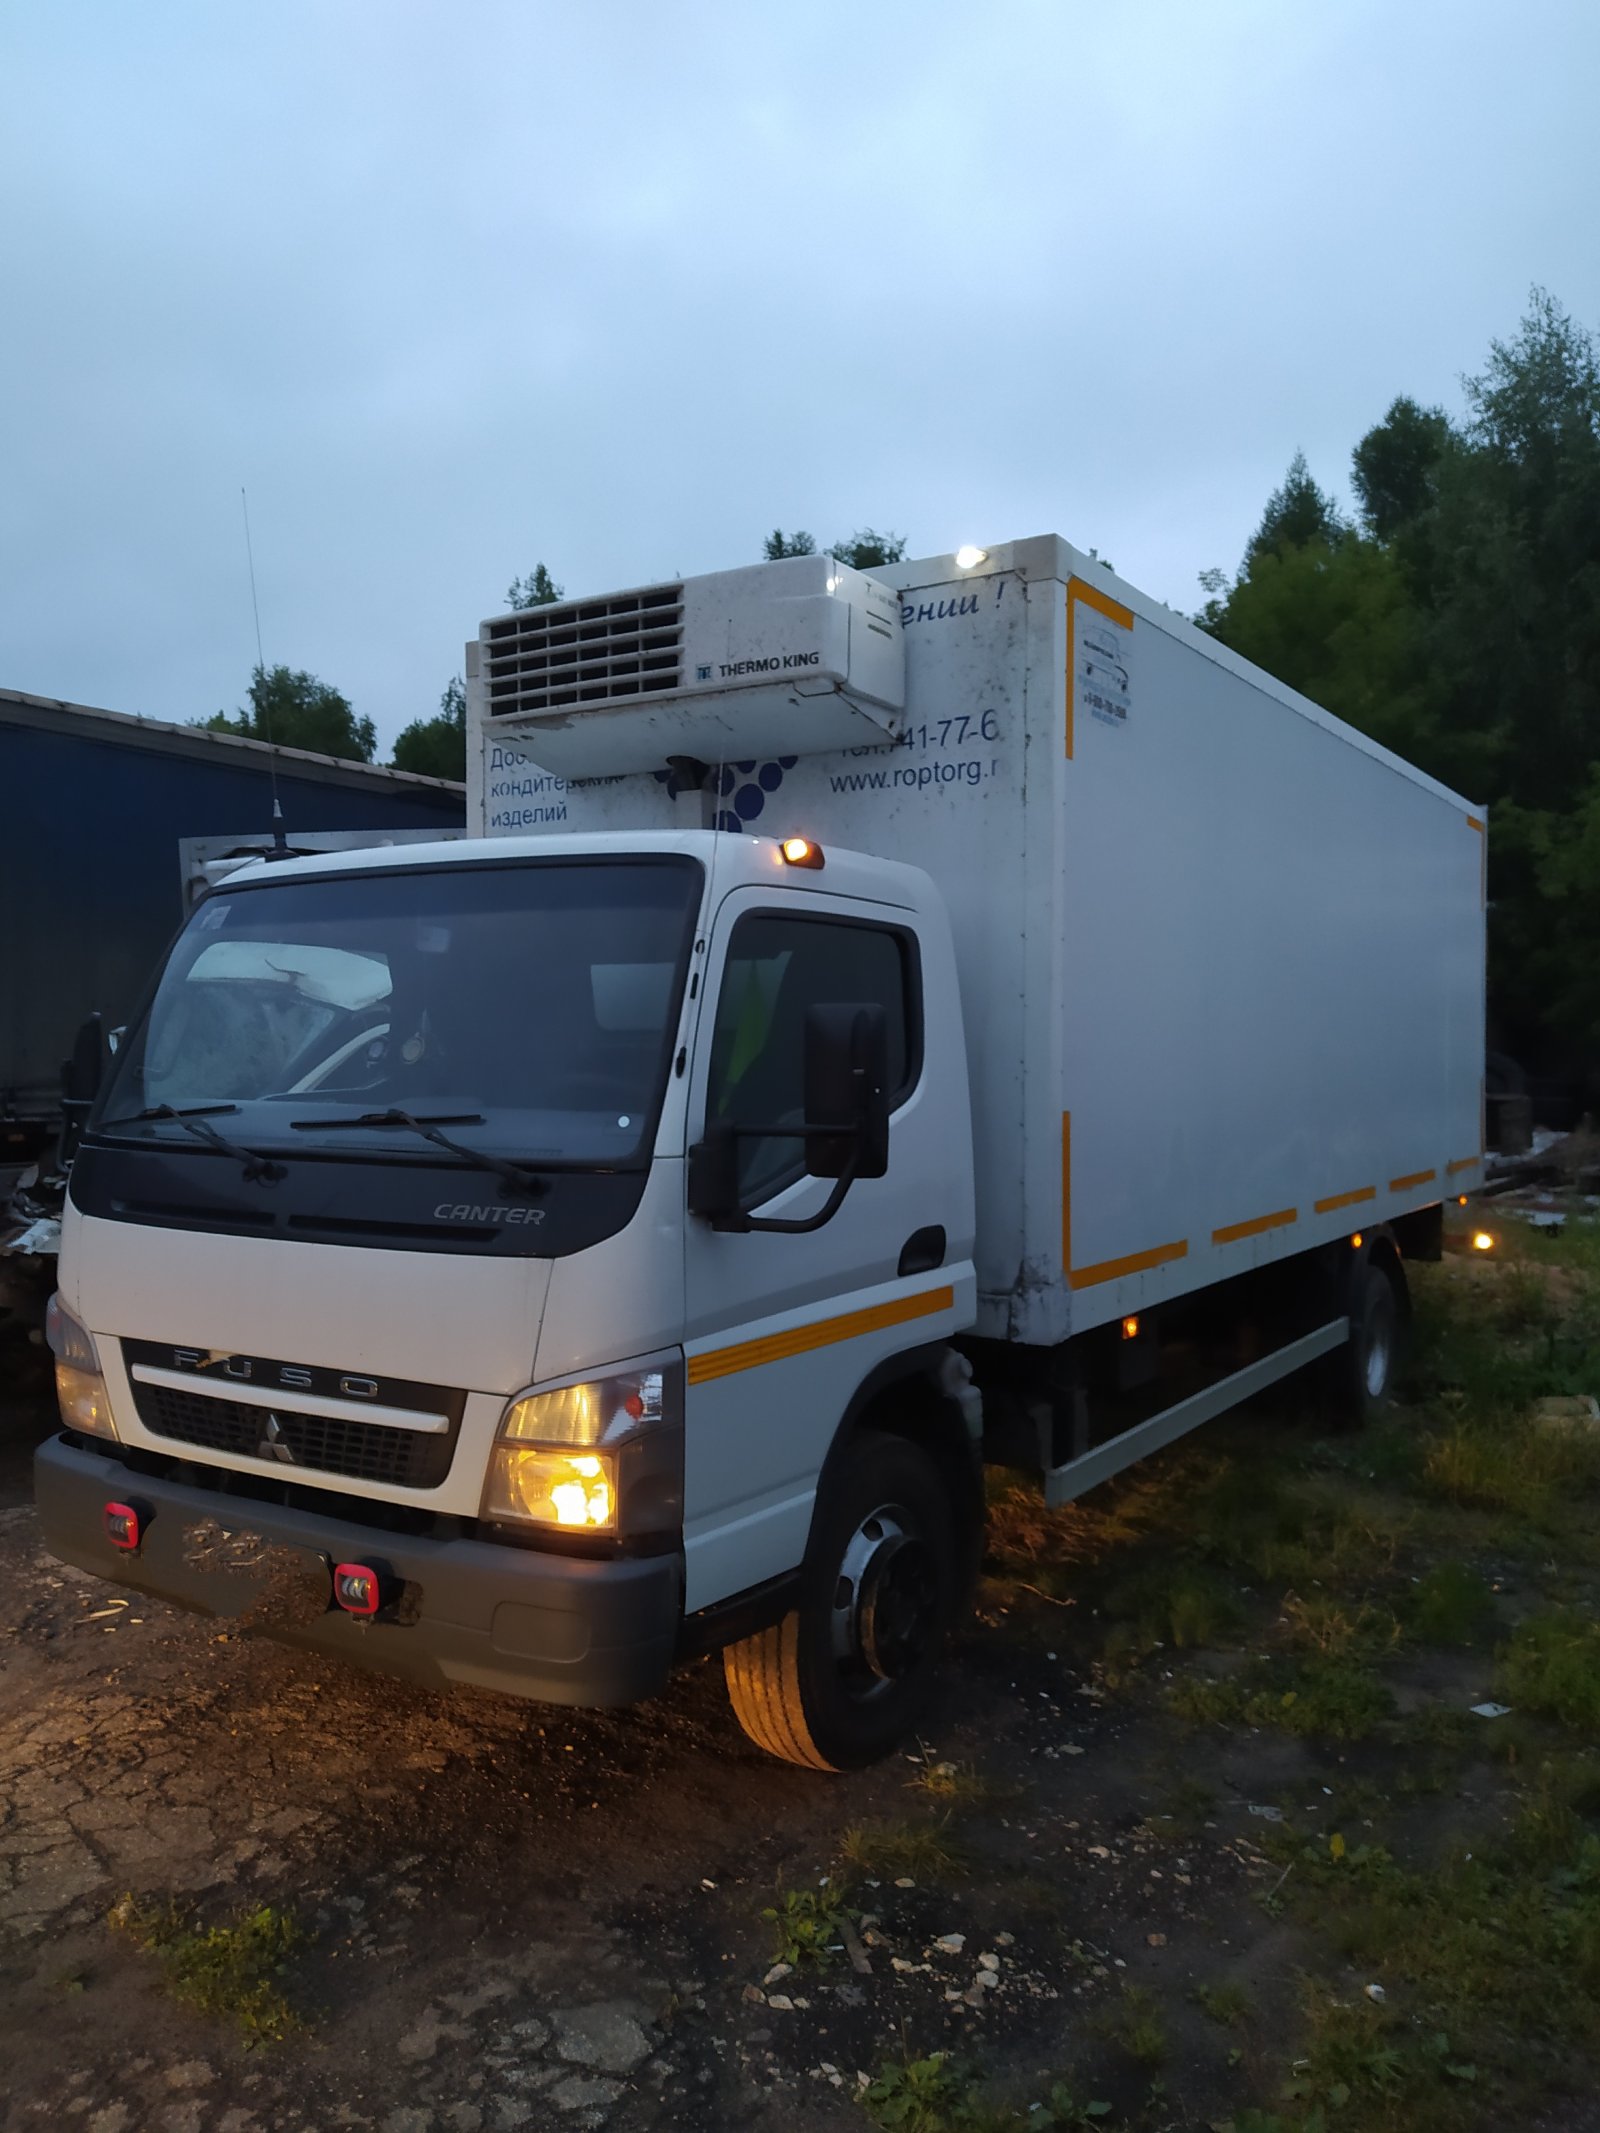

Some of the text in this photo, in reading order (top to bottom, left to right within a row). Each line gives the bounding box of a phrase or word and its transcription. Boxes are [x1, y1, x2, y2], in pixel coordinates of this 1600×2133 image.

[719, 657, 781, 678] THERMO
[782, 651, 820, 669] KING
[491, 801, 568, 829] изделий
[433, 1203, 546, 1226] CANTER
[174, 1349, 379, 1398] FUSO
